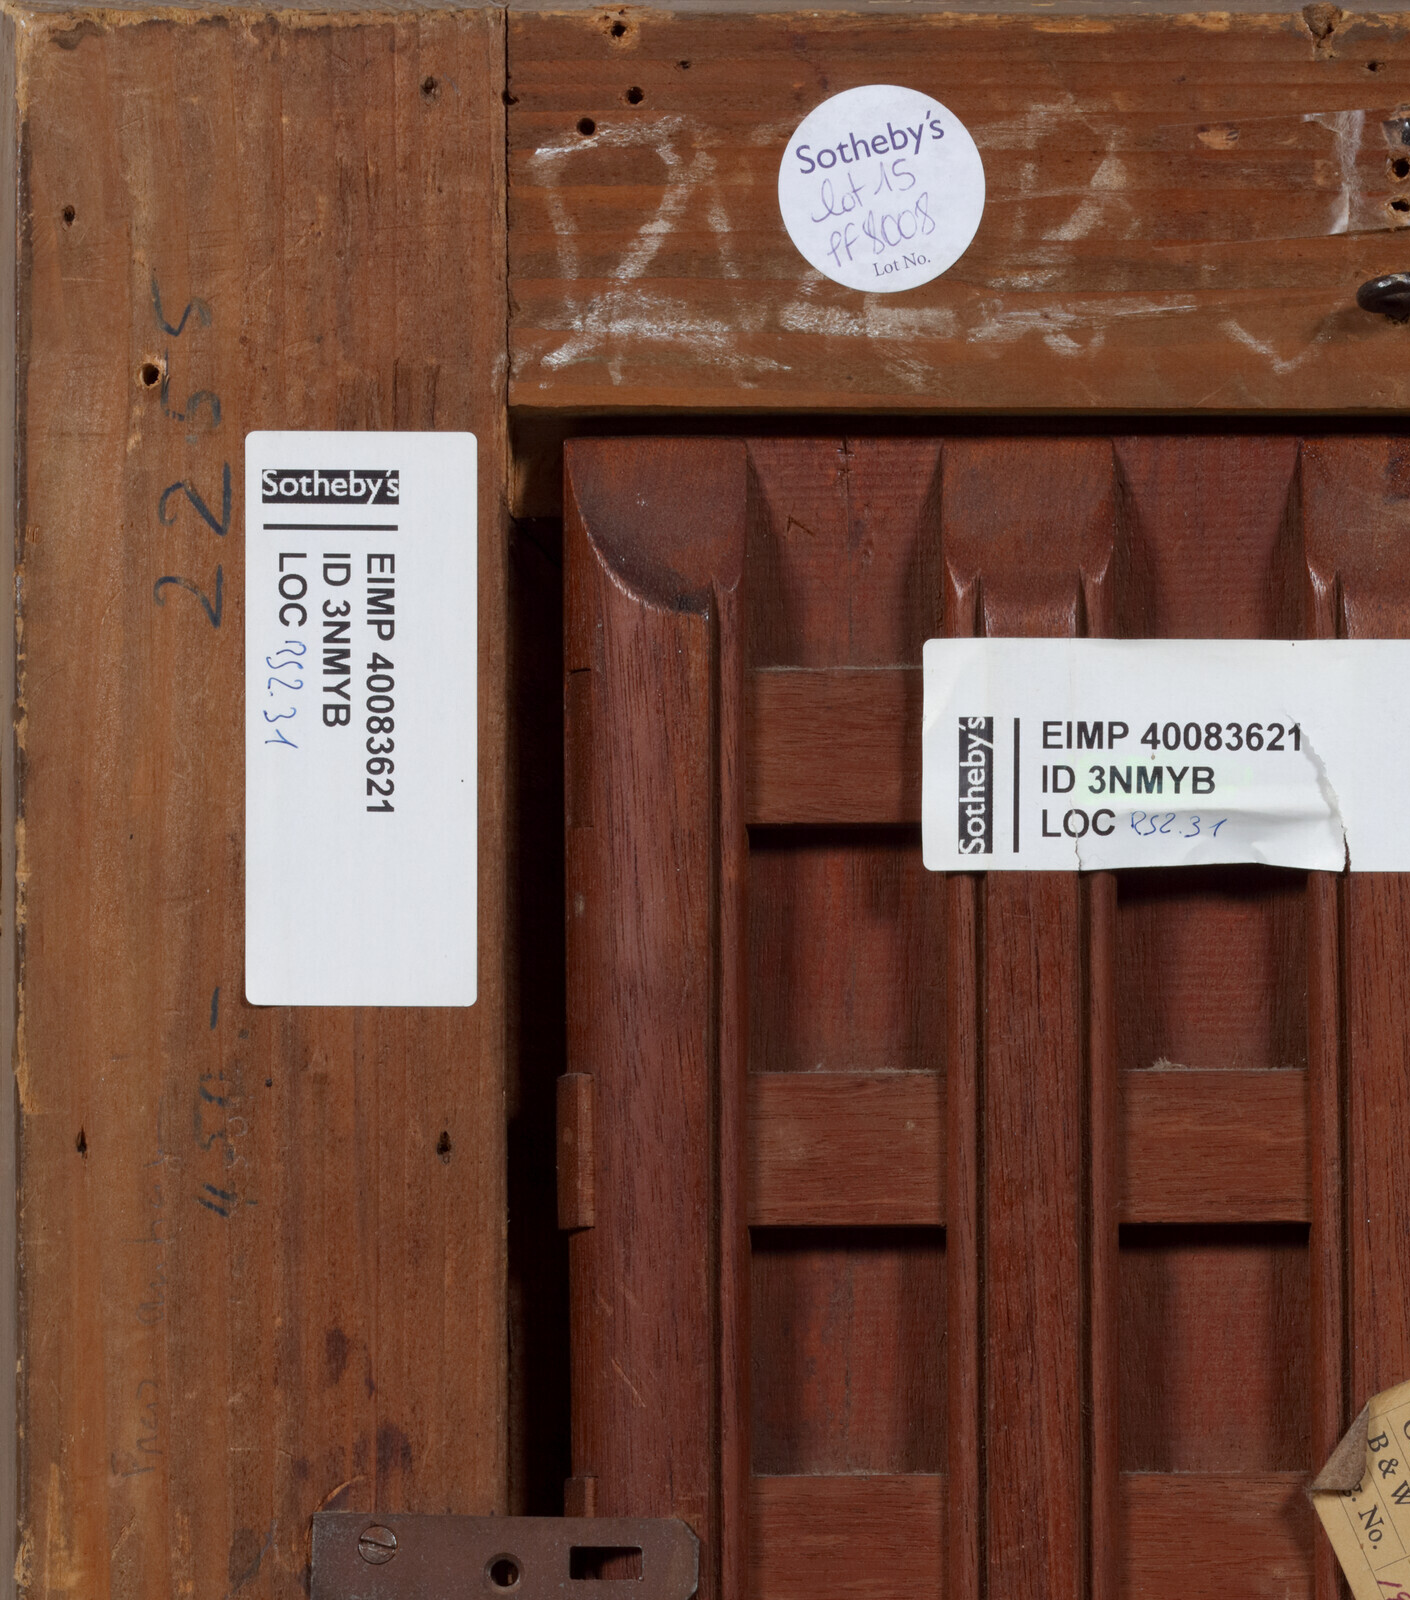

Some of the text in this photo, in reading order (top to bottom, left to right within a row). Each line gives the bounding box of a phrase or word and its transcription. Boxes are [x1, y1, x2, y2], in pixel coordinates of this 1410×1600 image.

[796, 110, 944, 174] Sotheby's
[812, 158, 916, 223] lot 15
[873, 253, 931, 277] Lot No.
[262, 470, 399, 504] Sotheby's
[278, 553, 307, 627] LOC
[322, 553, 351, 727] ID 3NMYB
[366, 553, 395, 813] EIMP 40083621
[1041, 721, 1301, 751] EIMP 40083621
[958, 717, 993, 854] Sotheby's
[1041, 766, 1216, 794] ID 3NMYB
[1041, 809, 1116, 837] LOC
[1368, 1431, 1390, 1453] B
[1378, 1458, 1398, 1480] &
[1358, 1504, 1386, 1550] No.
